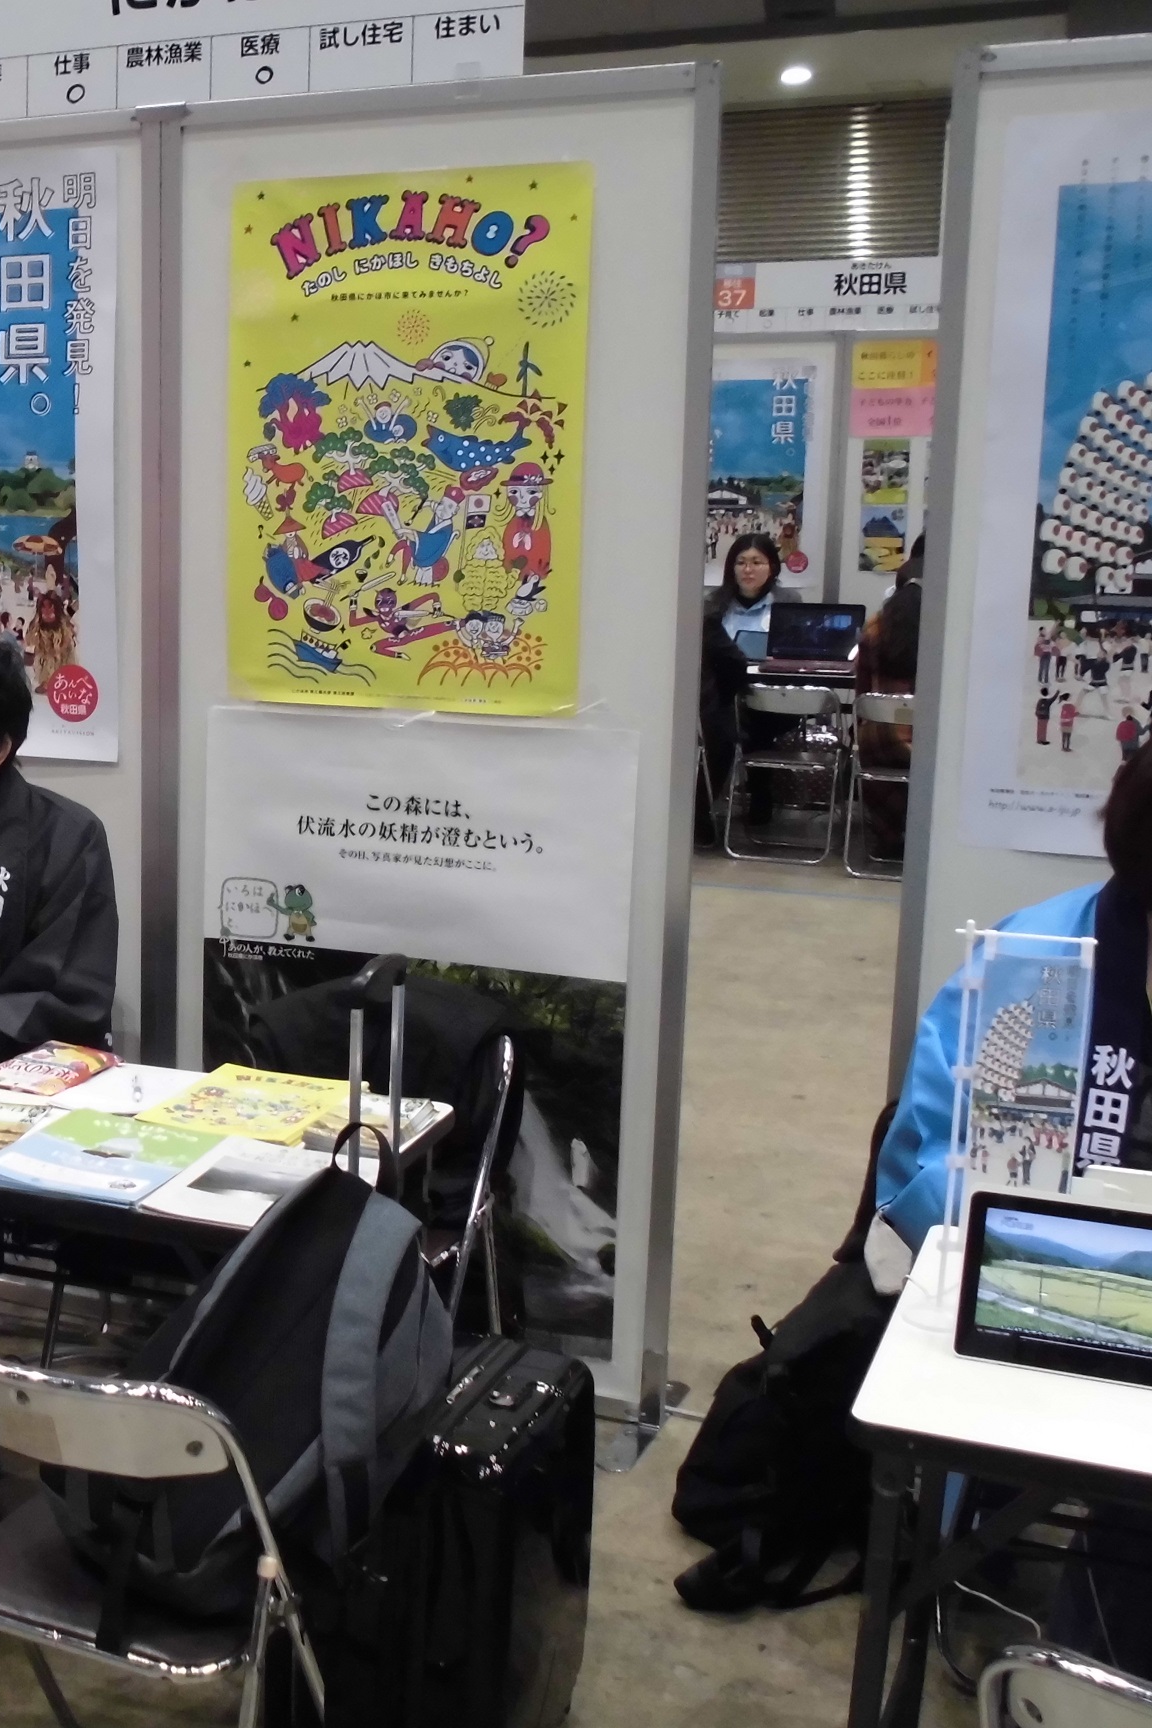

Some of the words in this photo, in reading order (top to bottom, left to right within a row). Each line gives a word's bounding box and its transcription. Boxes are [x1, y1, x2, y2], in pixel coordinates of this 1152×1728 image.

[319, 20, 404, 51] 試し住宅
[434, 14, 501, 40] 住まい
[126, 41, 203, 69] 農林漁業
[240, 33, 280, 58] 医療
[54, 53, 90, 76] 仕事
[270, 190, 551, 280] NIKAHO?
[301, 266, 348, 298] たのし
[353, 252, 420, 276] にかほし
[429, 253, 503, 290] きもちよし
[833, 272, 908, 297] 秋田県
[718, 289, 747, 307] 37
[366, 794, 471, 819] この森には、
[297, 813, 544, 854] 伏流水の妖精が澄むという。
[228, 943, 316, 959] あの人が、教えてくれた
[1076, 1044, 1136, 1169] 秋田県
